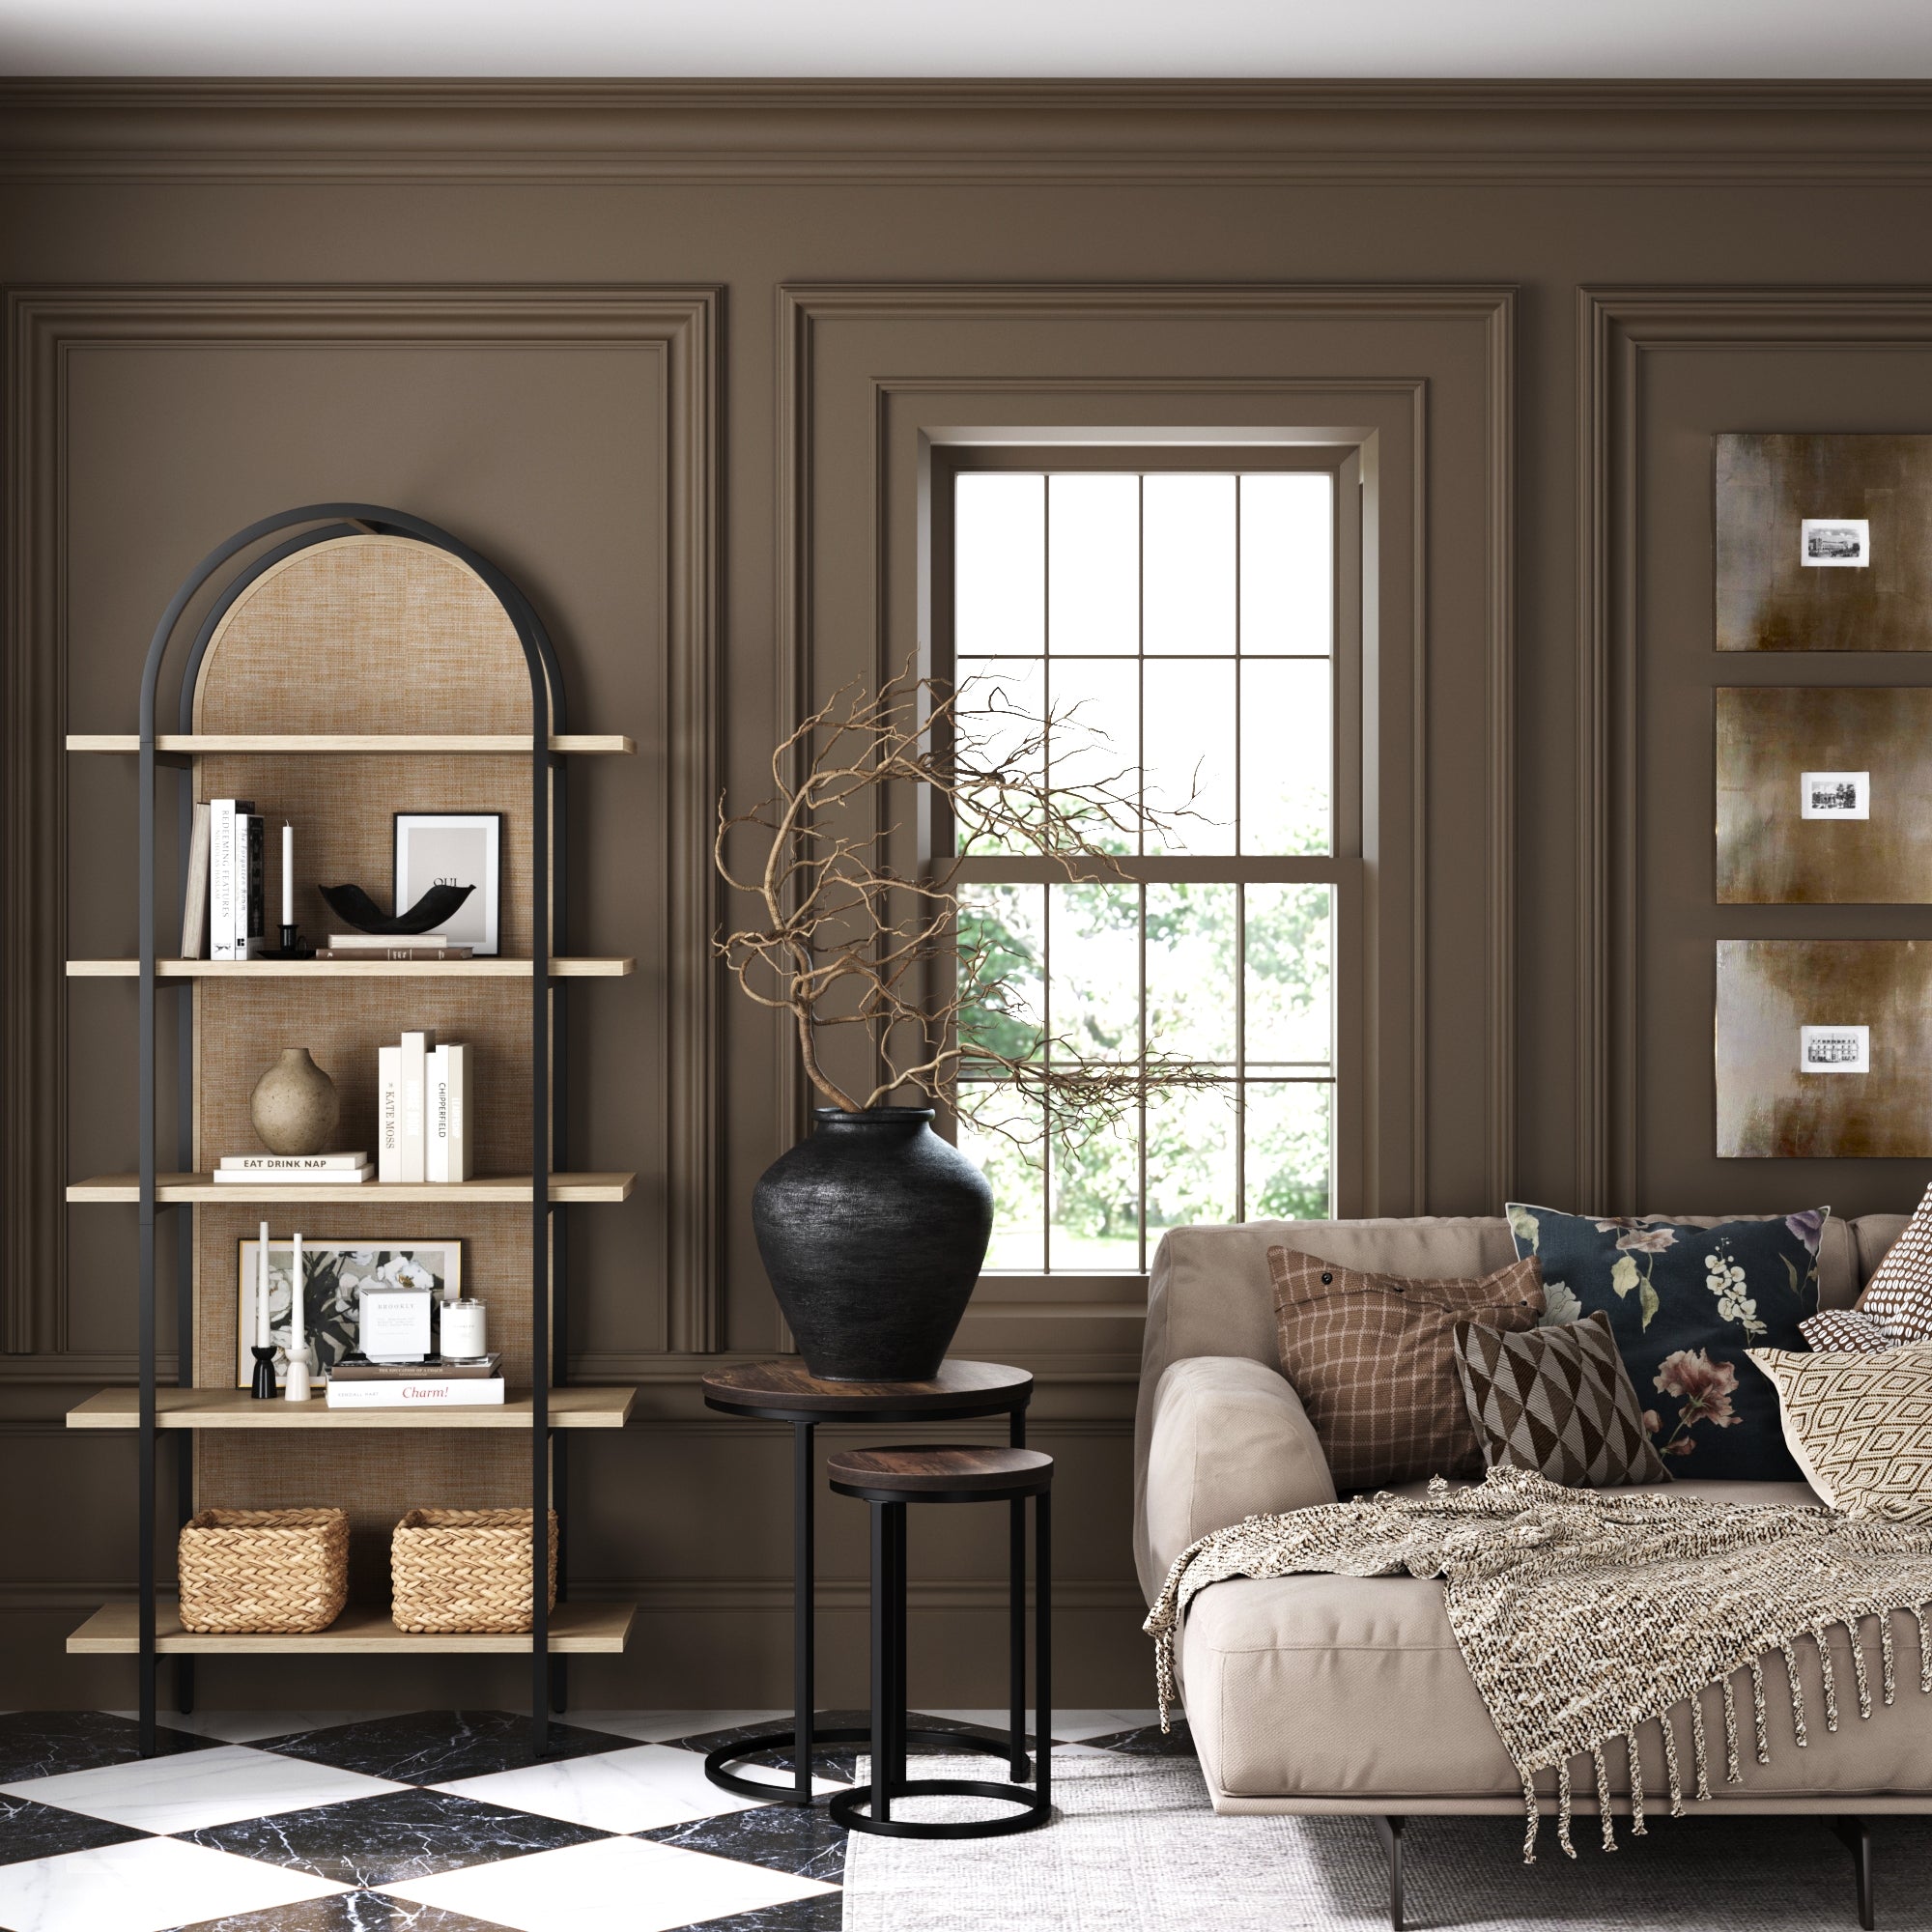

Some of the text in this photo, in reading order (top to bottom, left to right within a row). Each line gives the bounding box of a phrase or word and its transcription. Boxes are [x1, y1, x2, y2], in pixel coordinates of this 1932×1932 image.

[385, 1091, 395, 1150] KATE MOSS
[243, 1159, 327, 1168] EAT DRINK NAP
[402, 1386, 449, 1399] Charm!
